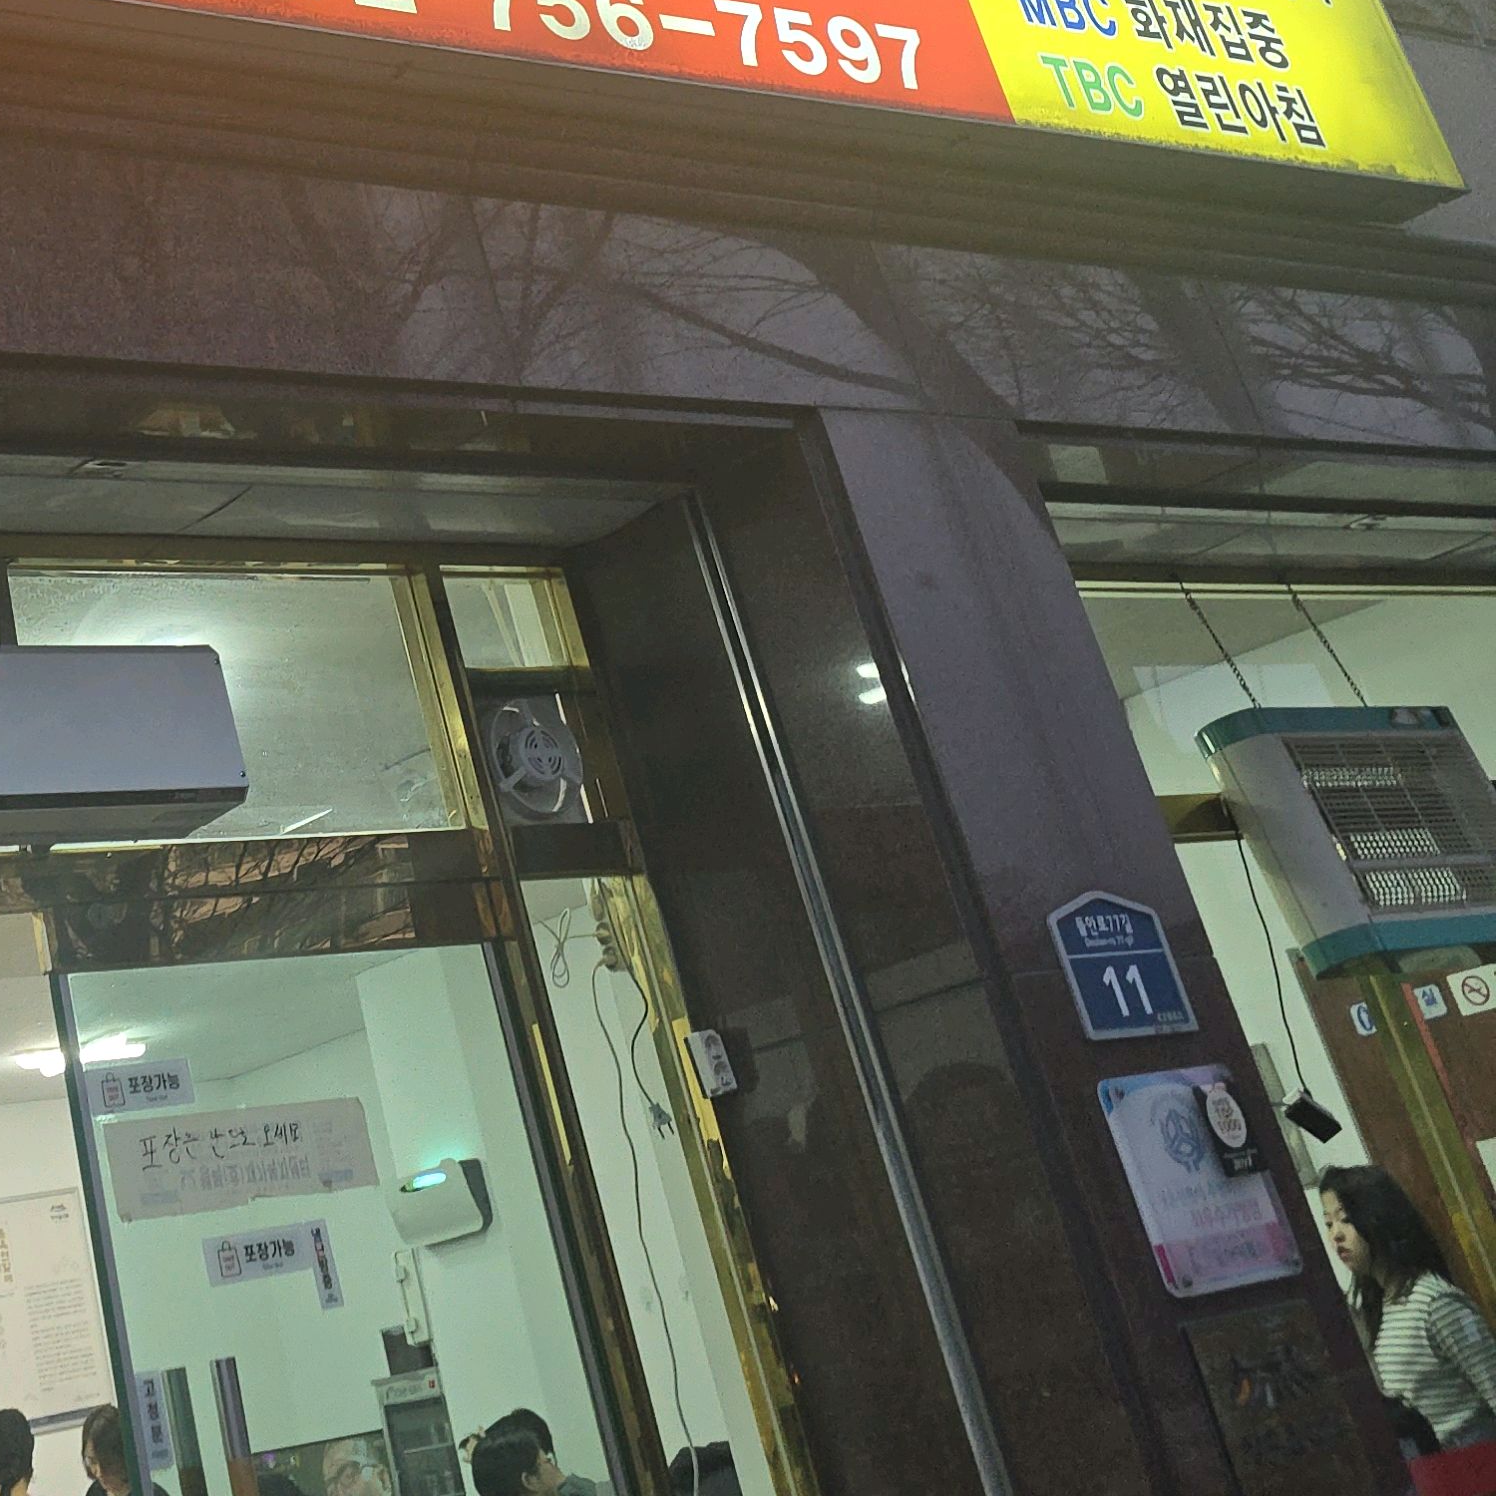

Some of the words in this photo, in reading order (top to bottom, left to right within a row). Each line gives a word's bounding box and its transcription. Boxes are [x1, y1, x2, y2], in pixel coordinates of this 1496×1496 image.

[1041, 53, 1144, 118] TBC
[1154, 65, 1327, 149] 열린아침
[1103, 964, 1154, 1018] 11
[127, 1071, 181, 1096] 포장가능
[243, 1236, 296, 1264] 포장가능
